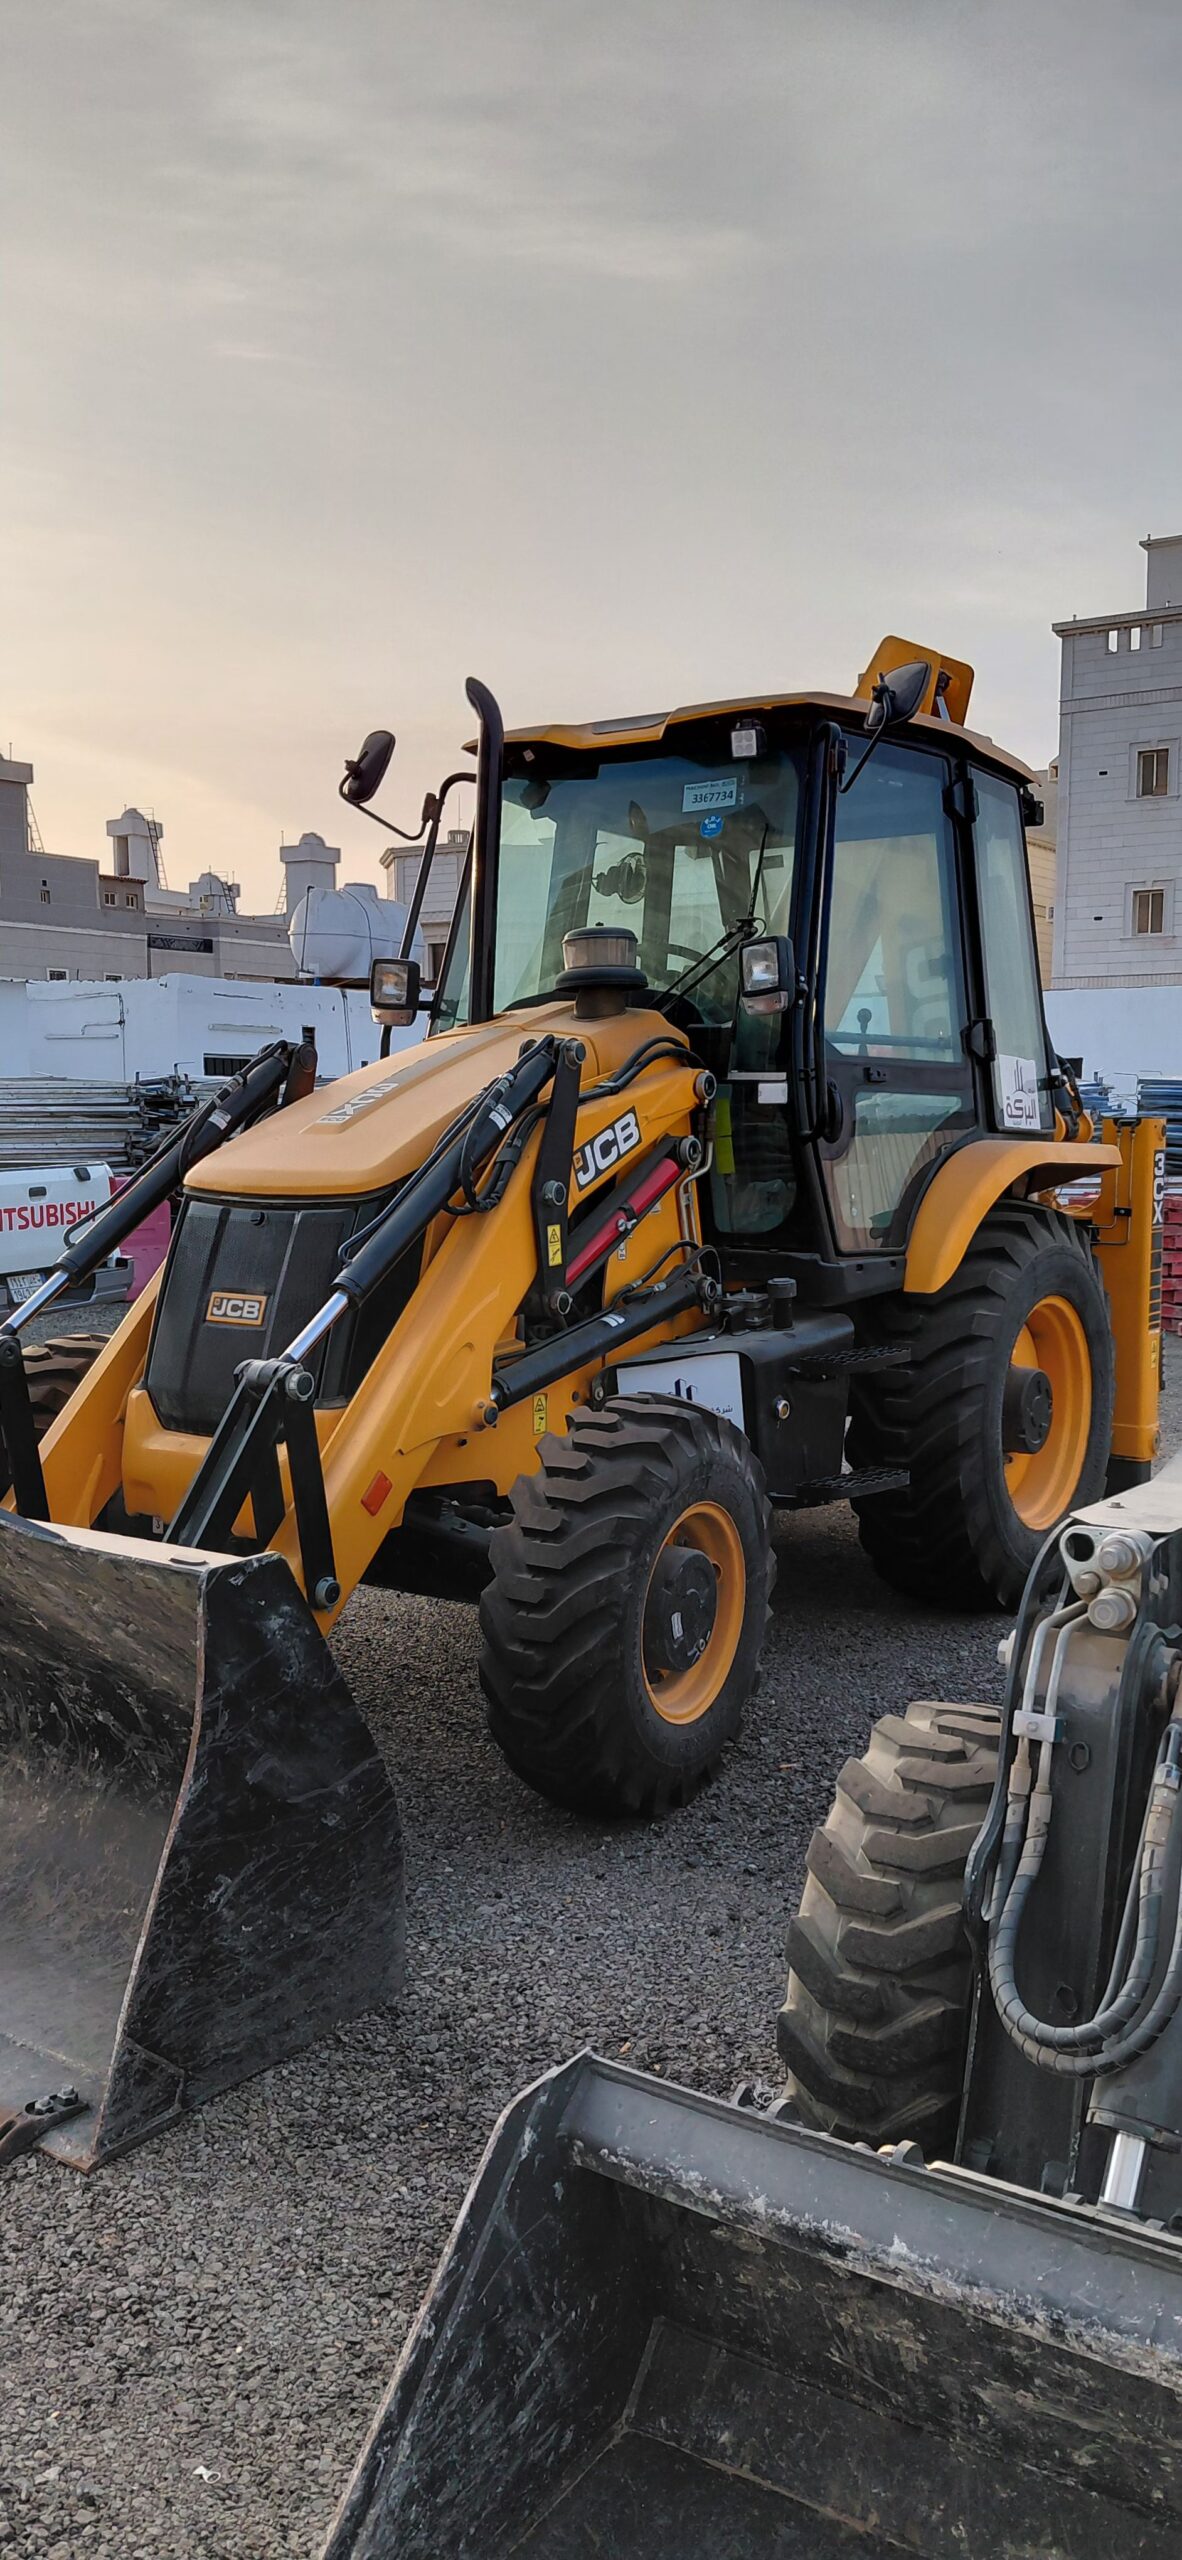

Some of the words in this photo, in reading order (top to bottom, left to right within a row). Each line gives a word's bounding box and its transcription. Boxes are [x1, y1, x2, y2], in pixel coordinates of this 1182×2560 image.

[691, 790, 734, 804] 3367734
[1006, 1095, 1037, 1127] البركة
[577, 1112, 640, 1185] JCB
[1152, 1152, 1165, 1225] 3CX
[212, 1298, 260, 1319] JCB
